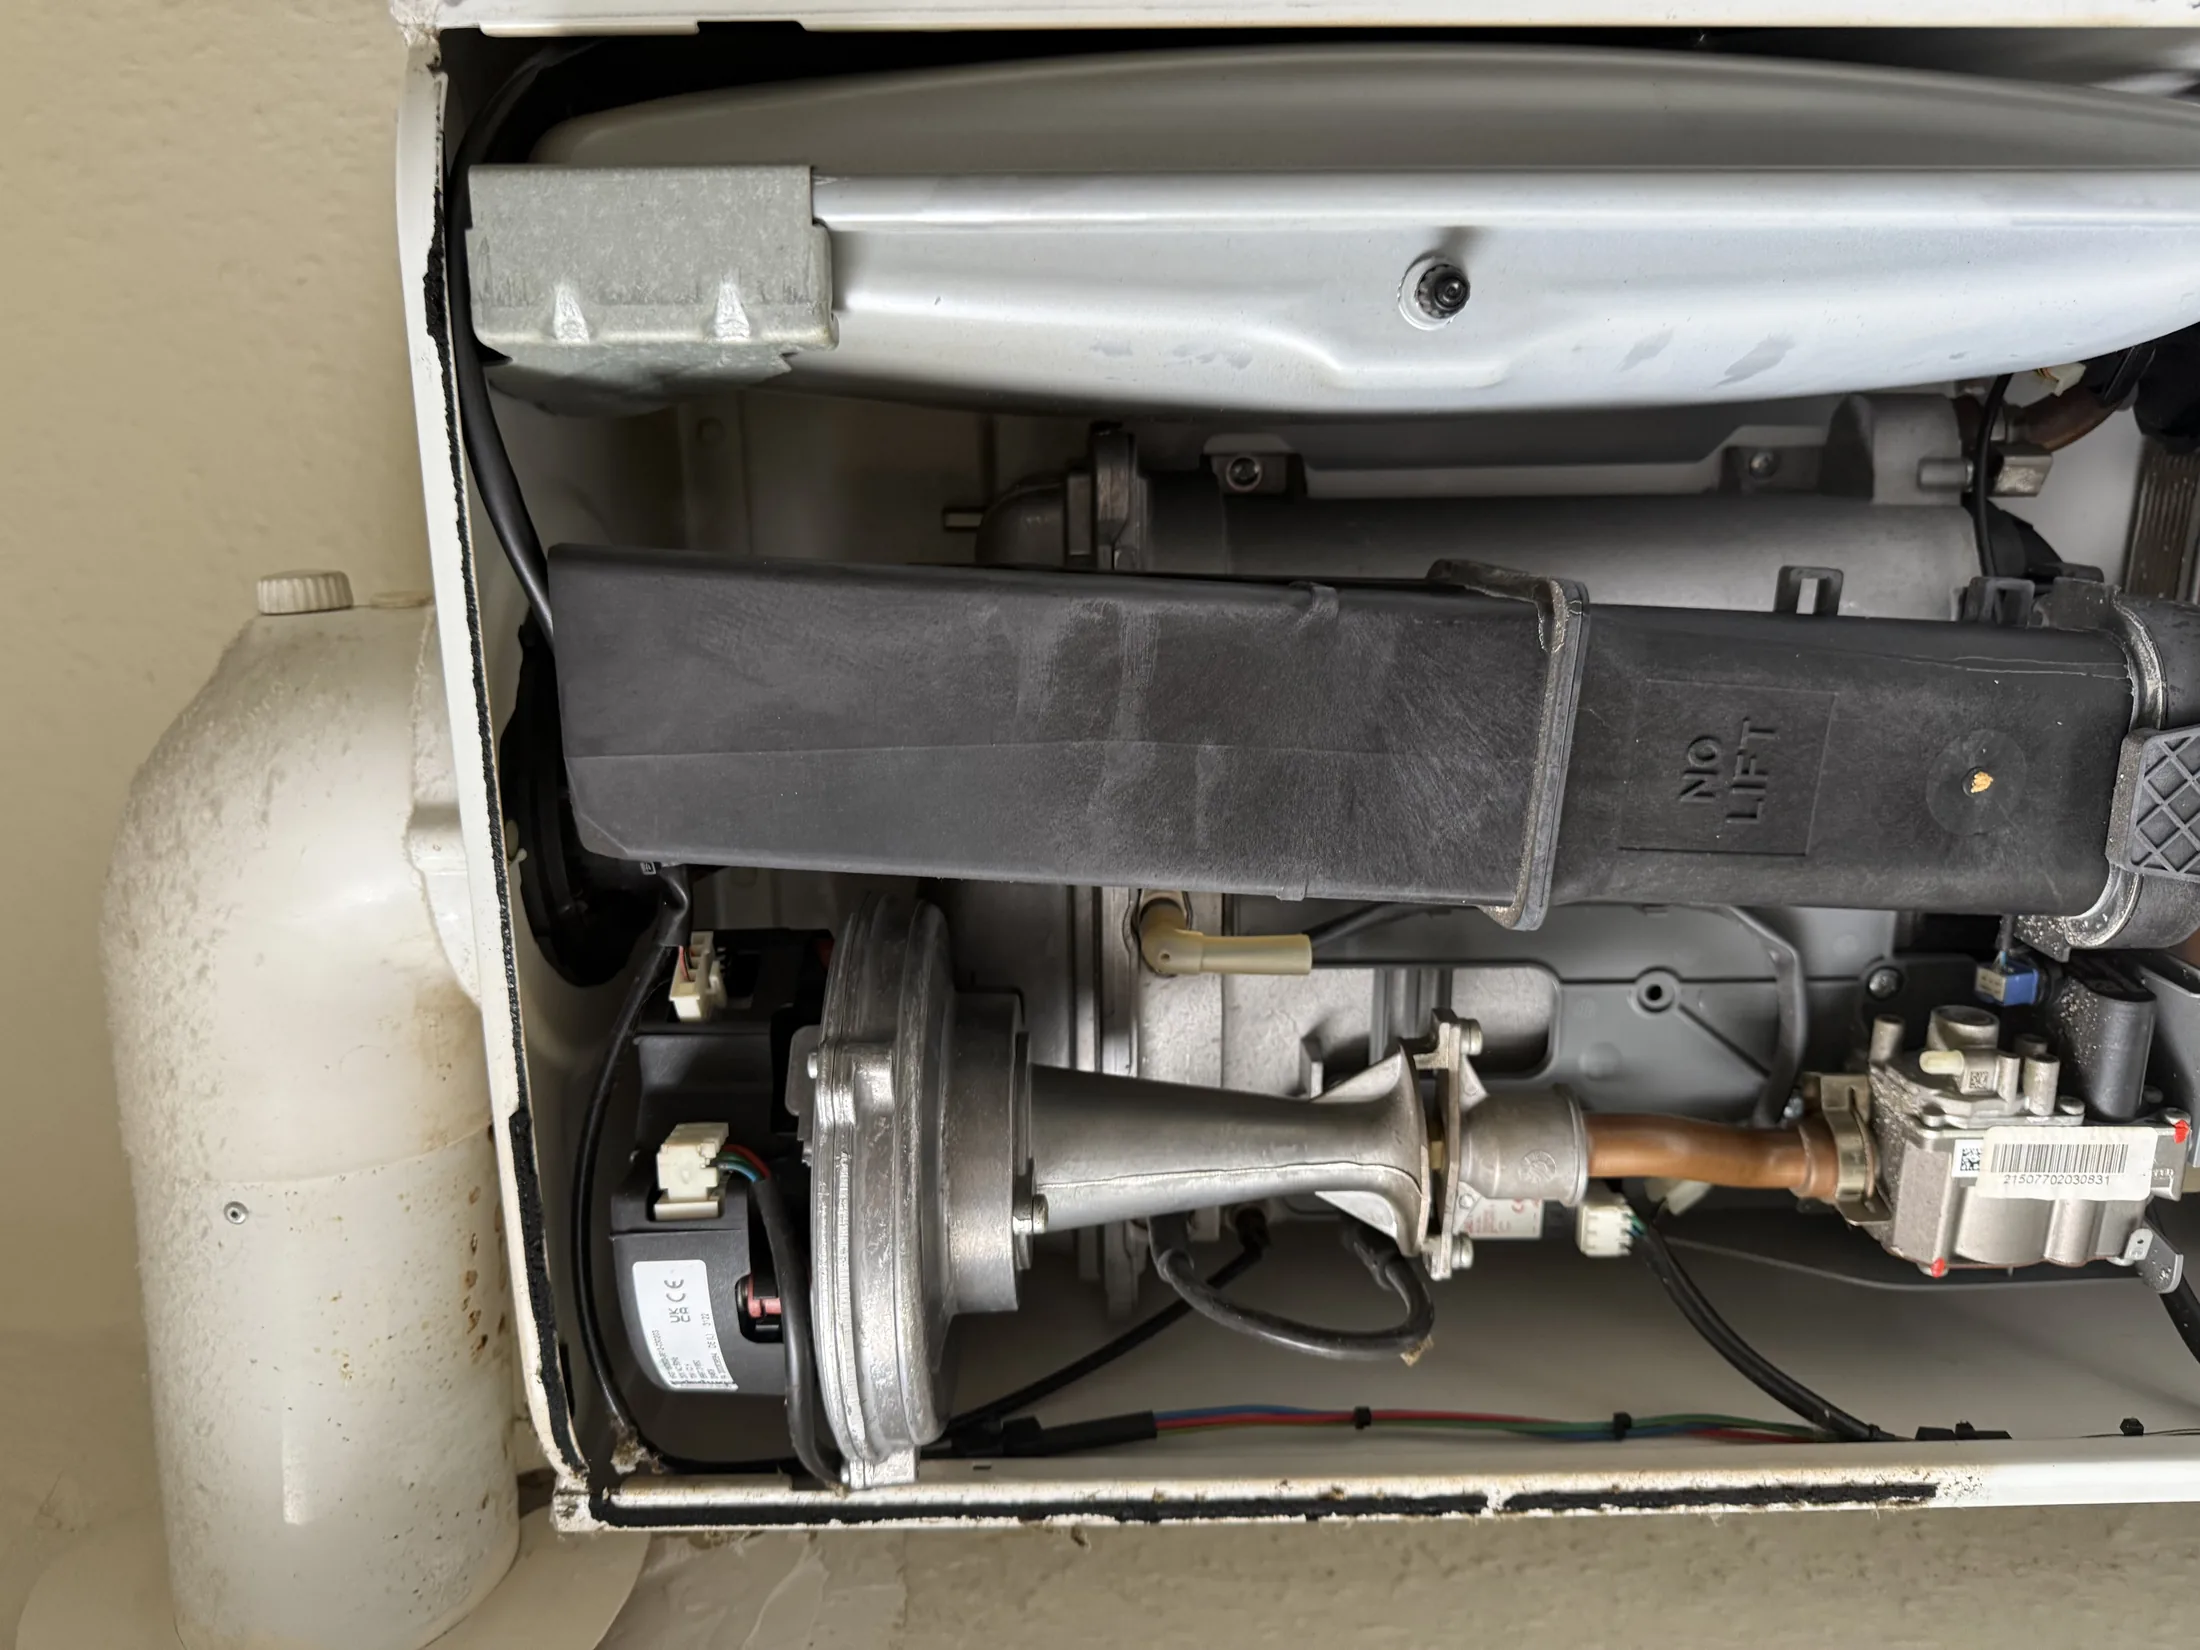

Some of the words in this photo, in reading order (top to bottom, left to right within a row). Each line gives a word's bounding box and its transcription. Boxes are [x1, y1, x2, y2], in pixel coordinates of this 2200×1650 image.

[1680, 735, 1722, 803] NO
[1725, 717, 1780, 824] LIFT
[2003, 1174, 2110, 1186] 21507702030831
[664, 1279, 686, 1303] CE
[669, 1306, 681, 1324] UK
[680, 1306, 691, 1323] CA
